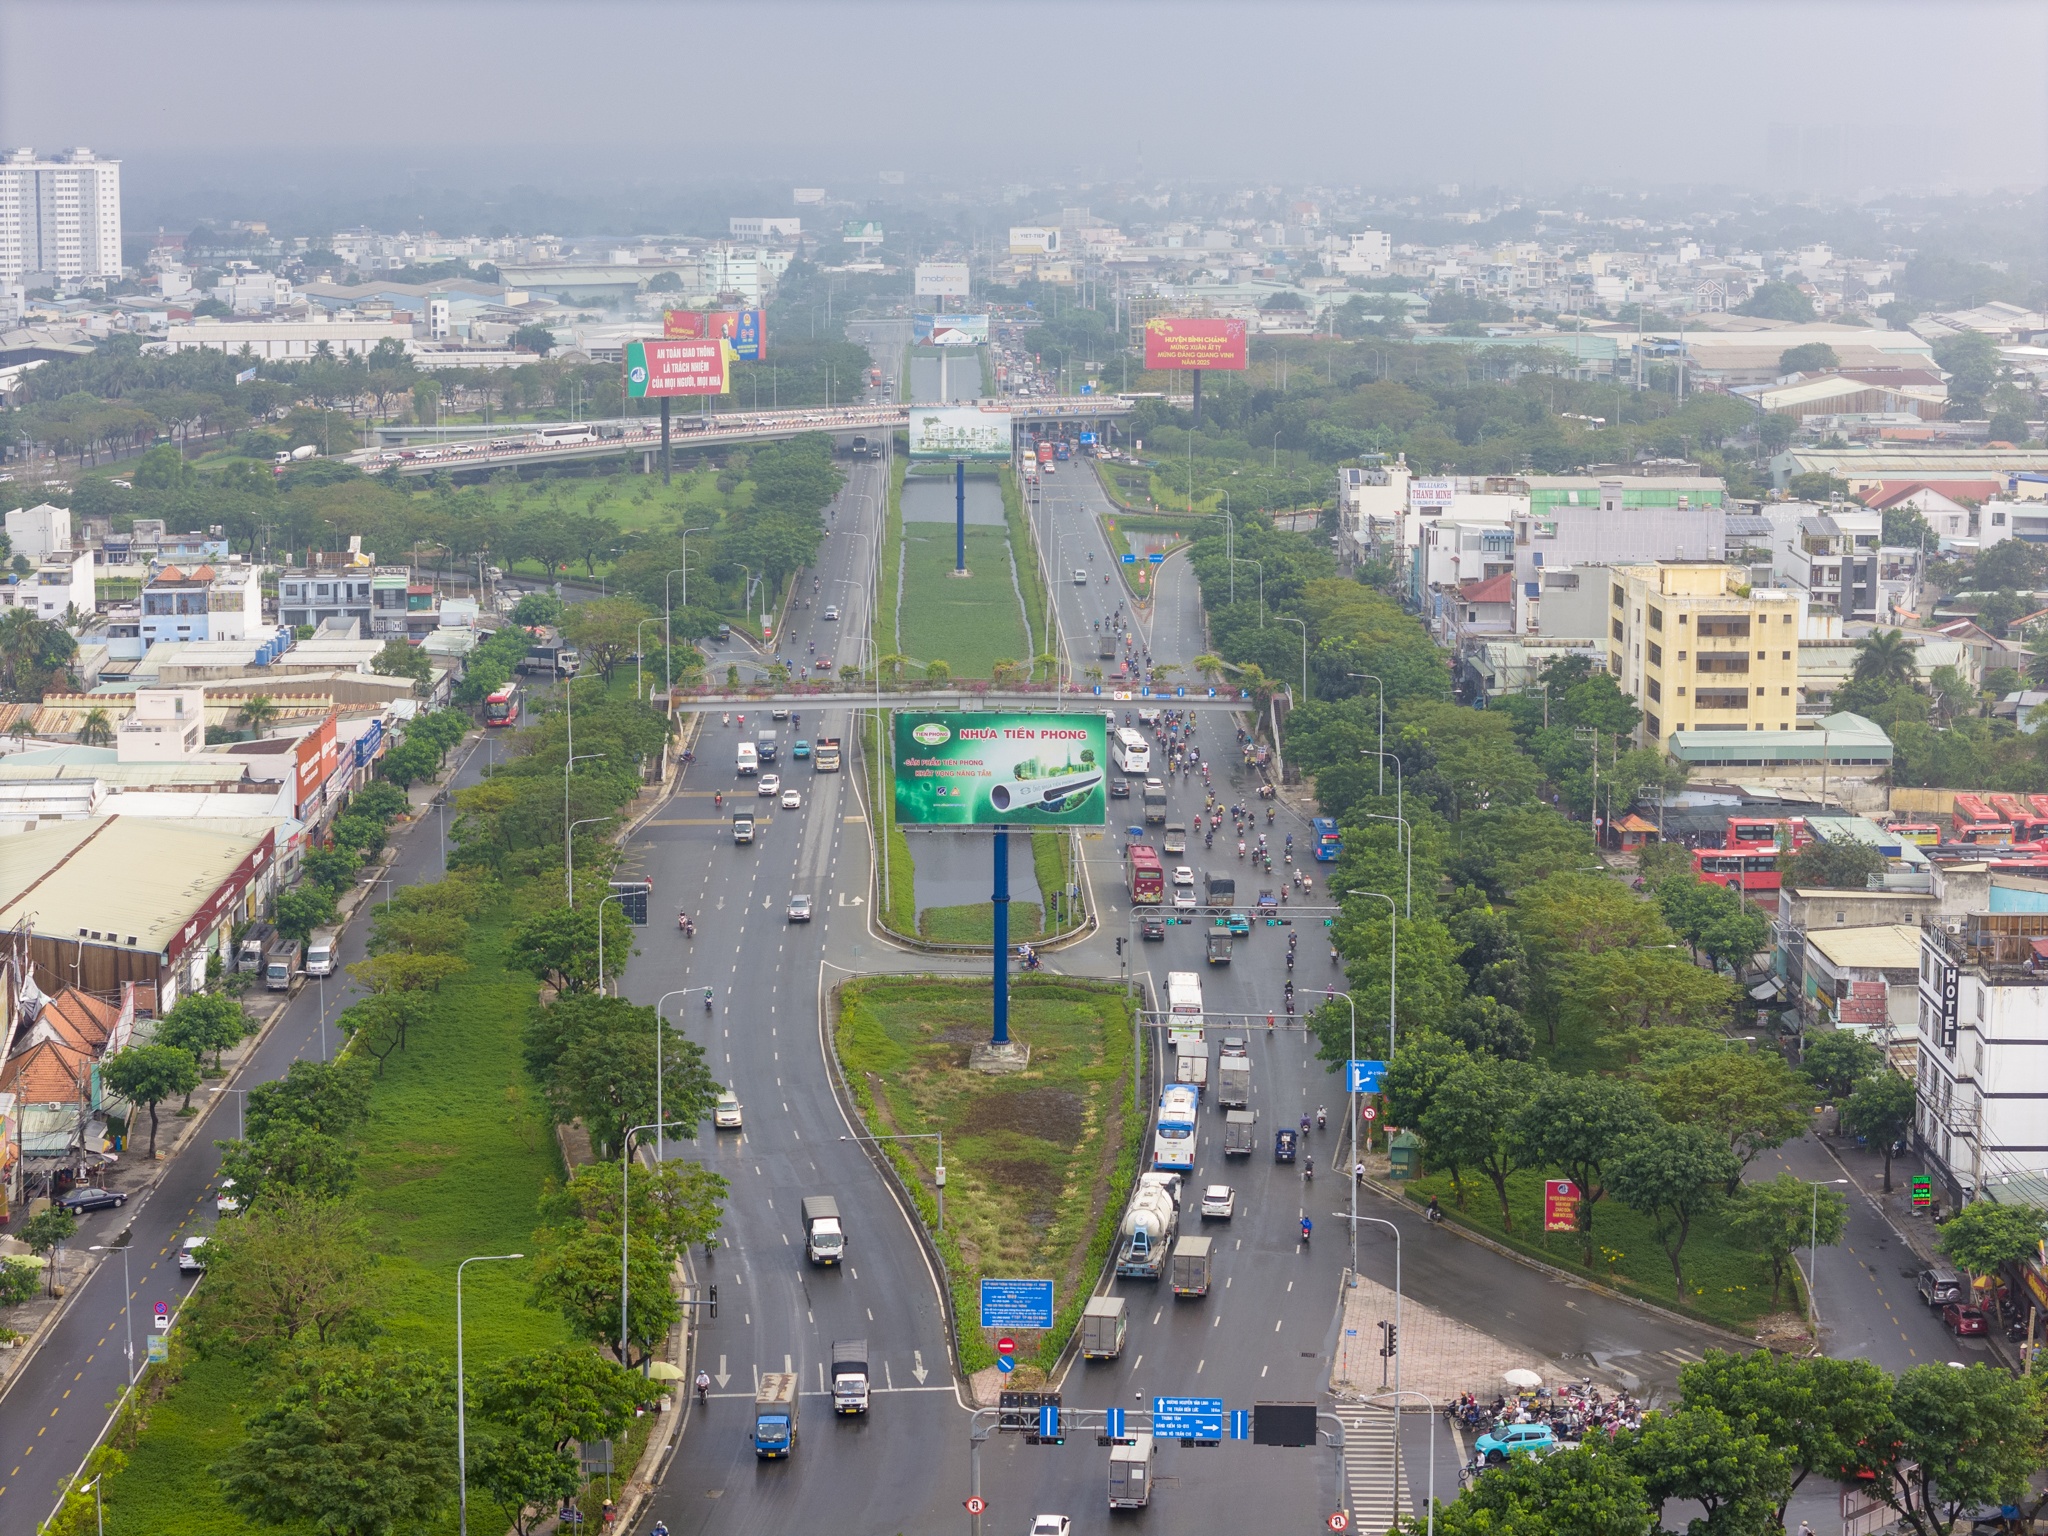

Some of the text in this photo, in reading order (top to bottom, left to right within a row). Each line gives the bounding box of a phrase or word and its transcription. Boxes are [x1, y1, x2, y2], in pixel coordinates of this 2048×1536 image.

[1165, 335, 1187, 344] HUYỆN
[657, 345, 715, 359] AN TOÀN GIAO THÔNG
[663, 360, 709, 374] LÀ TRÁCH NHIỆM
[652, 376, 663, 388] CỦA
[665, 378, 675, 390] MỌI
[697, 376, 708, 388] MỌI
[709, 374, 721, 386] NHÀ
[1412, 490, 1451, 499] THANH MINH
[960, 727, 1087, 742] NHỰA TIỀN PHONG
[906, 758, 920, 766] SẢN
[1944, 969, 1956, 1045] HOTEL
